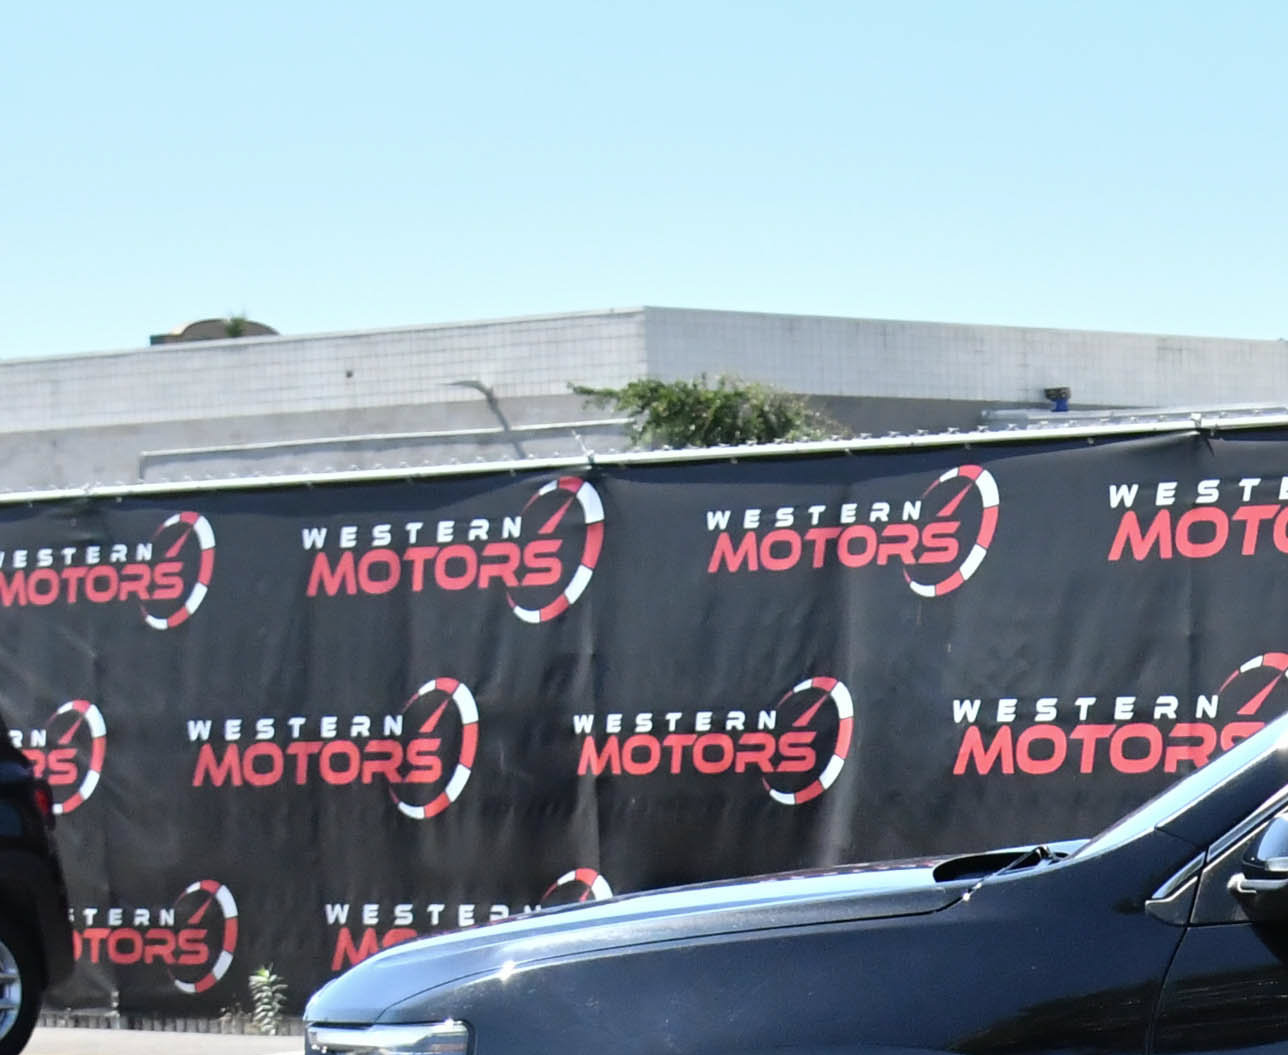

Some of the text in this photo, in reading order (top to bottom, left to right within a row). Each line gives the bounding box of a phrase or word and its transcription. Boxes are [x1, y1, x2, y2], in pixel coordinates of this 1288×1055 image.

[302, 515, 523, 550] WESTERN
[706, 500, 923, 531] WESTERN
[0, 542, 154, 569] ESTERN
[706, 520, 962, 574] MOTORS
[0, 561, 185, 607] MOTORS
[305, 538, 565, 598] MOTORS
[573, 710, 778, 735] WESTERN
[952, 694, 1220, 724] WESTERN
[187, 715, 404, 742] WESTERN
[191, 738, 444, 788] MOTORS
[576, 724, 819, 777] MOTORS
[69, 907, 176, 927] TERN
[72, 927, 209, 965] TORS
